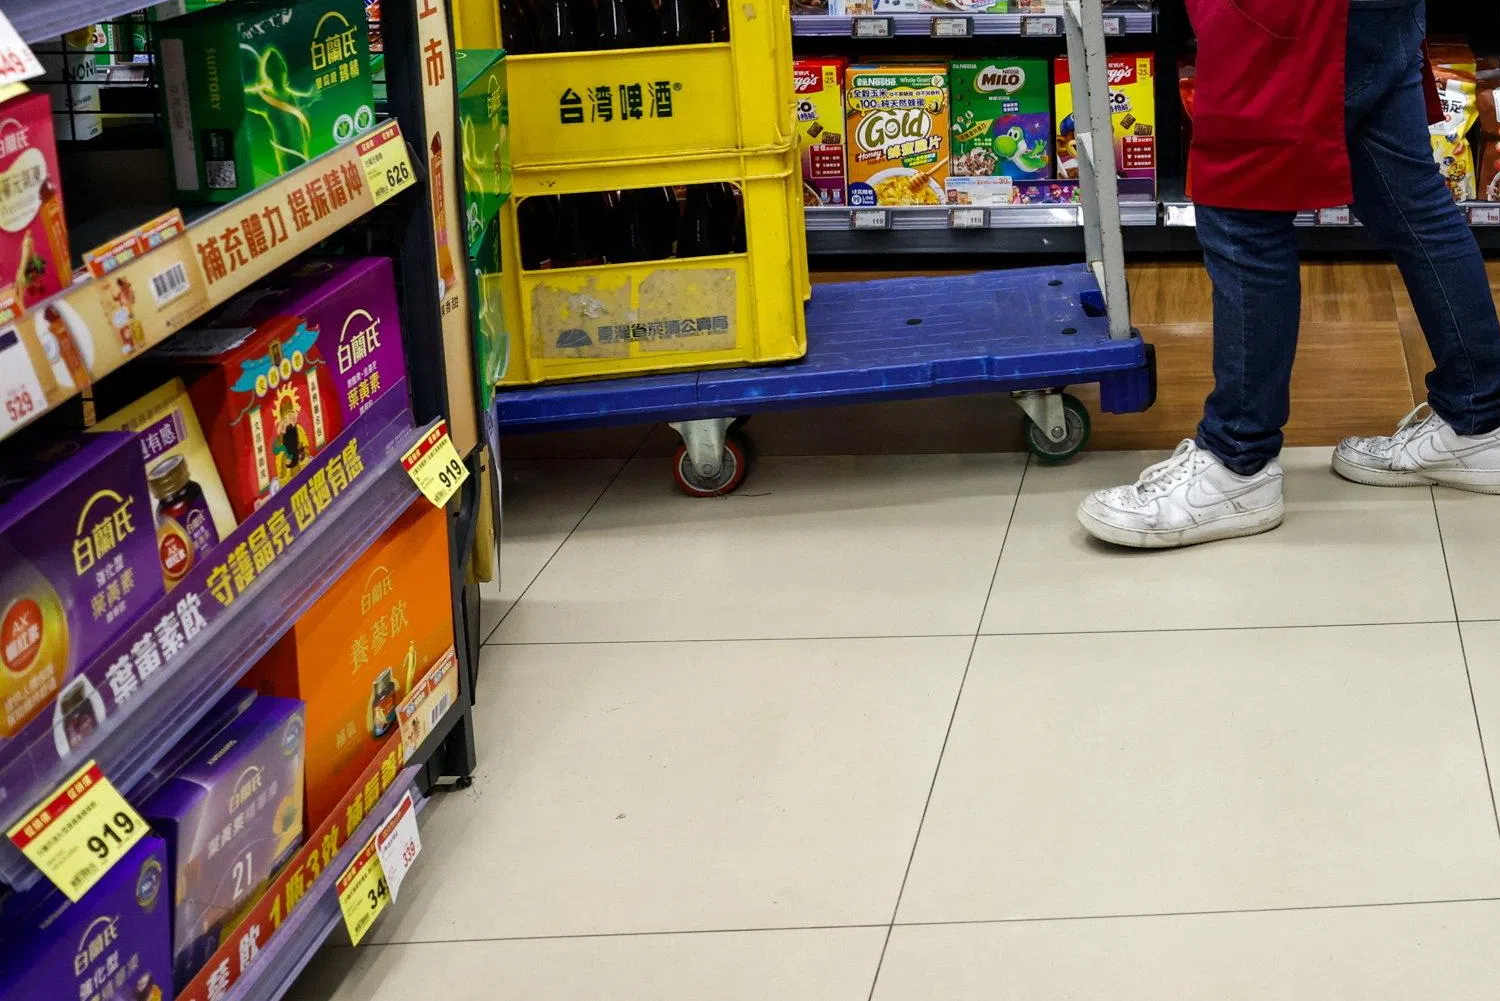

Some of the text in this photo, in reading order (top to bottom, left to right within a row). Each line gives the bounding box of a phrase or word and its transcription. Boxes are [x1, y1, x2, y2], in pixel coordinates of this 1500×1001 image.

[310, 25, 359, 71] 白蘭氏
[204, 46, 221, 112] SUNTORY
[981, 73, 1020, 86] MILO
[864, 109, 925, 145] Gold
[386, 161, 409, 188] 626
[857, 150, 882, 162] Honey
[197, 159, 366, 286] 補充體力 提振精神
[336, 320, 382, 375] 白蘭氏
[438, 458, 463, 490] 919
[72, 495, 136, 577] 白蘭氏
[361, 574, 394, 616] 白蘭氏
[105, 591, 208, 706] 葉黃素飲
[86, 810, 136, 859] 919
[231, 851, 253, 901] 21
[74, 918, 120, 978] 白蘭氏
